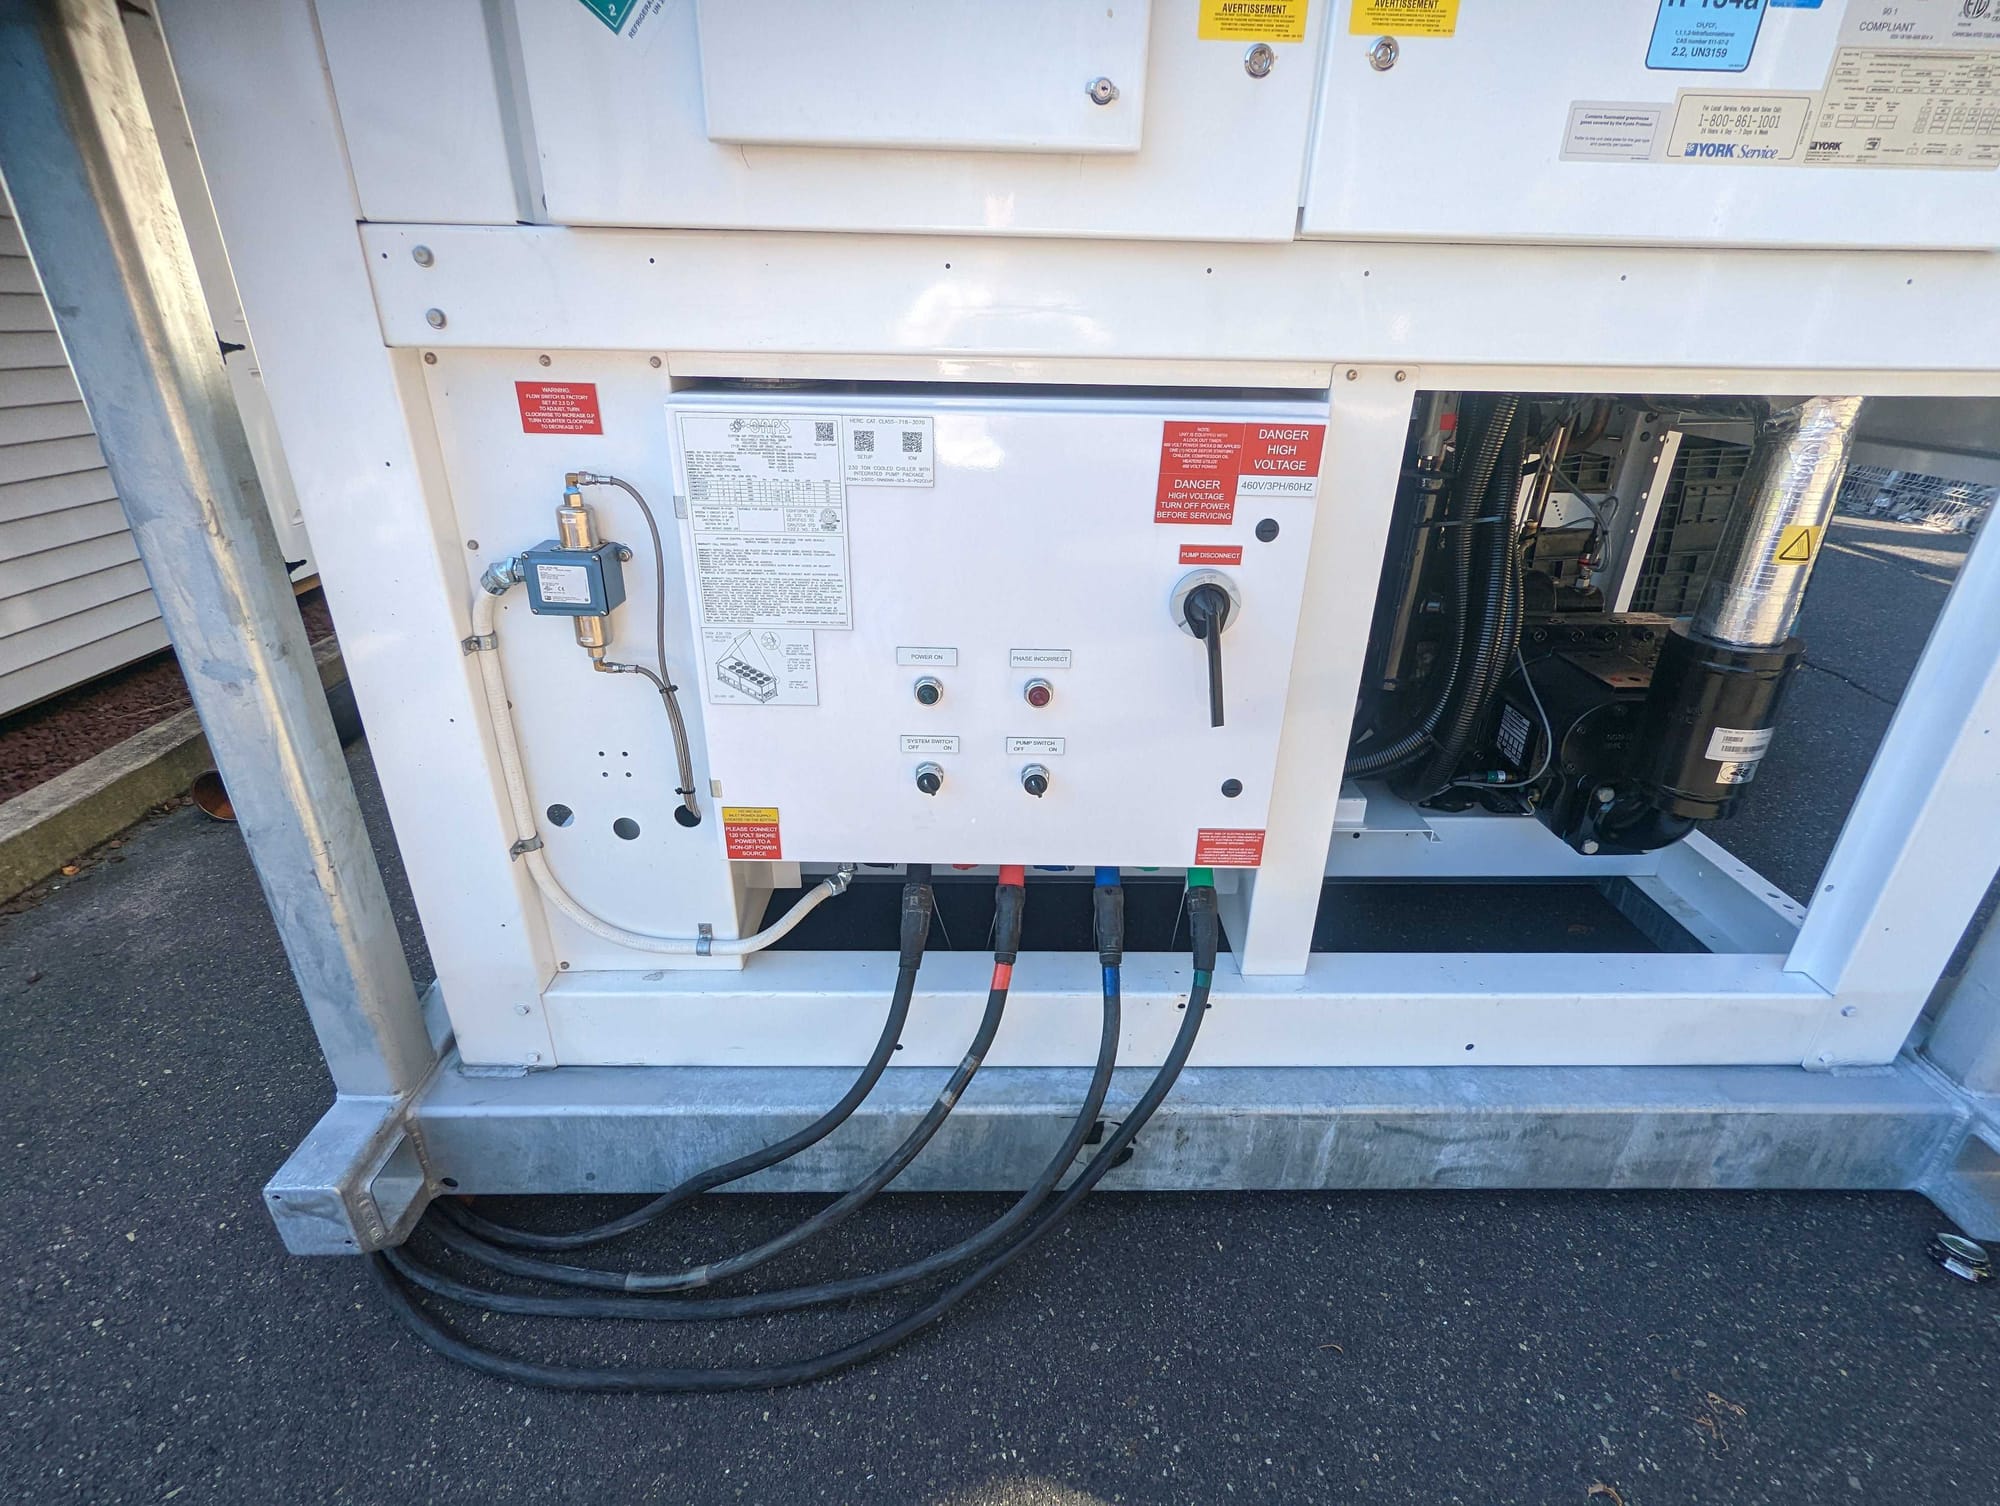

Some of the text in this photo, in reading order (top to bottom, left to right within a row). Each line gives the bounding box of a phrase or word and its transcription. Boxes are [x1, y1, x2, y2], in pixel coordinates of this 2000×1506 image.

[609, 4, 616, 16] 2
[1223, 3, 1287, 14] AVERTISSEMENT
[1375, 0, 1439, 9] AVERTISSEMENT
[628, 0, 655, 39] REFRIGERA
[1859, 22, 1916, 32] COMPLIANT
[1672, 47, 1727, 58] 2.2, UN3159
[1698, 114, 1781, 129] 1-800-861-1001
[1699, 143, 1779, 159] YORK Service
[1816, 142, 1843, 151] YORK
[1258, 429, 1309, 440] DANGER
[1267, 445, 1296, 455] HIGH
[1254, 459, 1307, 471] VOLTAGE
[1174, 480, 1221, 489] DANGER
[1241, 481, 1313, 492] 460V/3PH/60HZ
[1200, 502, 1230, 510] POWER
[1157, 511, 1232, 520] BEFORE SERVICING
